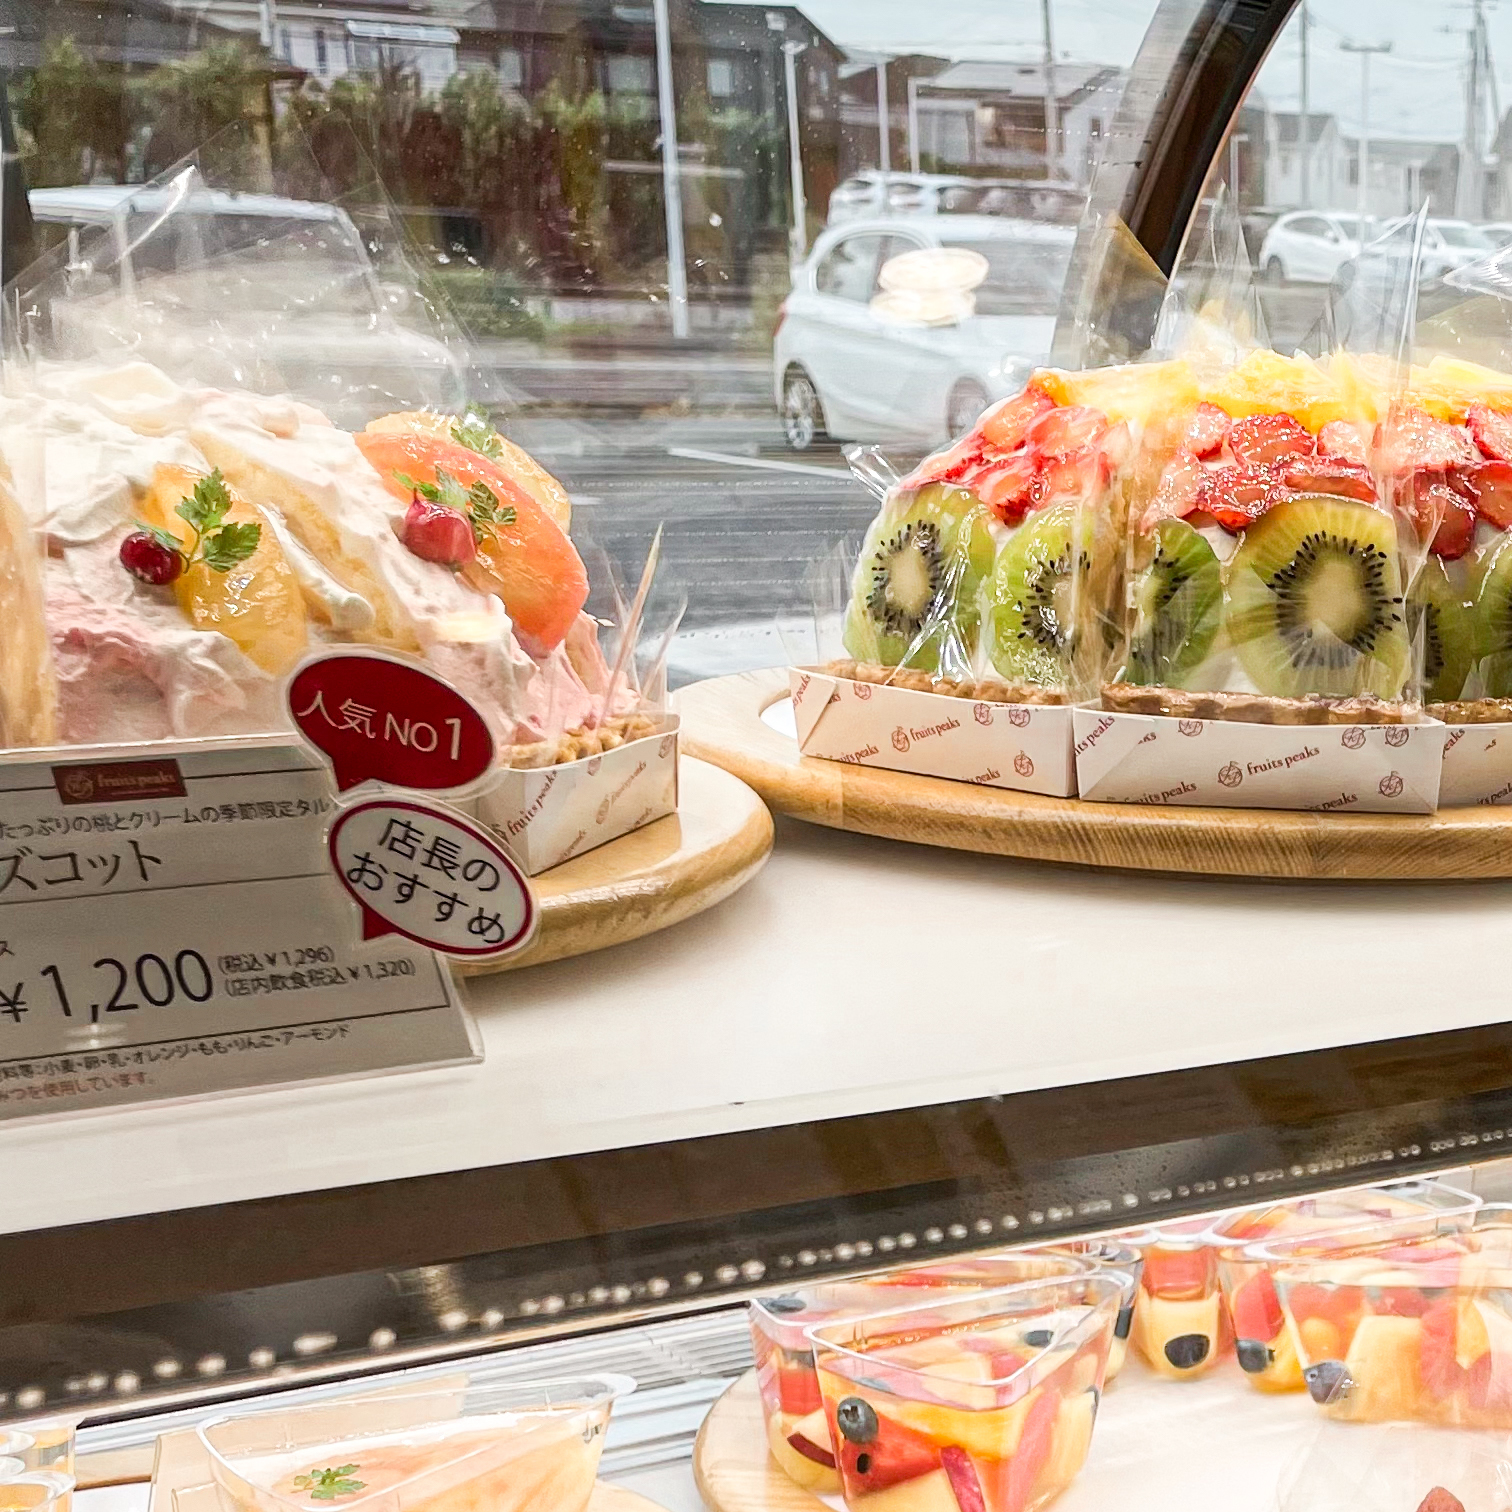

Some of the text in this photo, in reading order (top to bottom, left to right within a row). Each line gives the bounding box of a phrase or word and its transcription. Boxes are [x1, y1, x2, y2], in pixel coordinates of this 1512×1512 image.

[910, 716, 961, 741] fruits peaks
[1086, 715, 1116, 748] peaks
[1247, 745, 1320, 776] fruits peaks
[1161, 780, 1197, 803] peaks
[377, 817, 501, 892] 店長の
[346, 851, 505, 944] おすすめ
[0, 948, 214, 1024] ¥1,200
